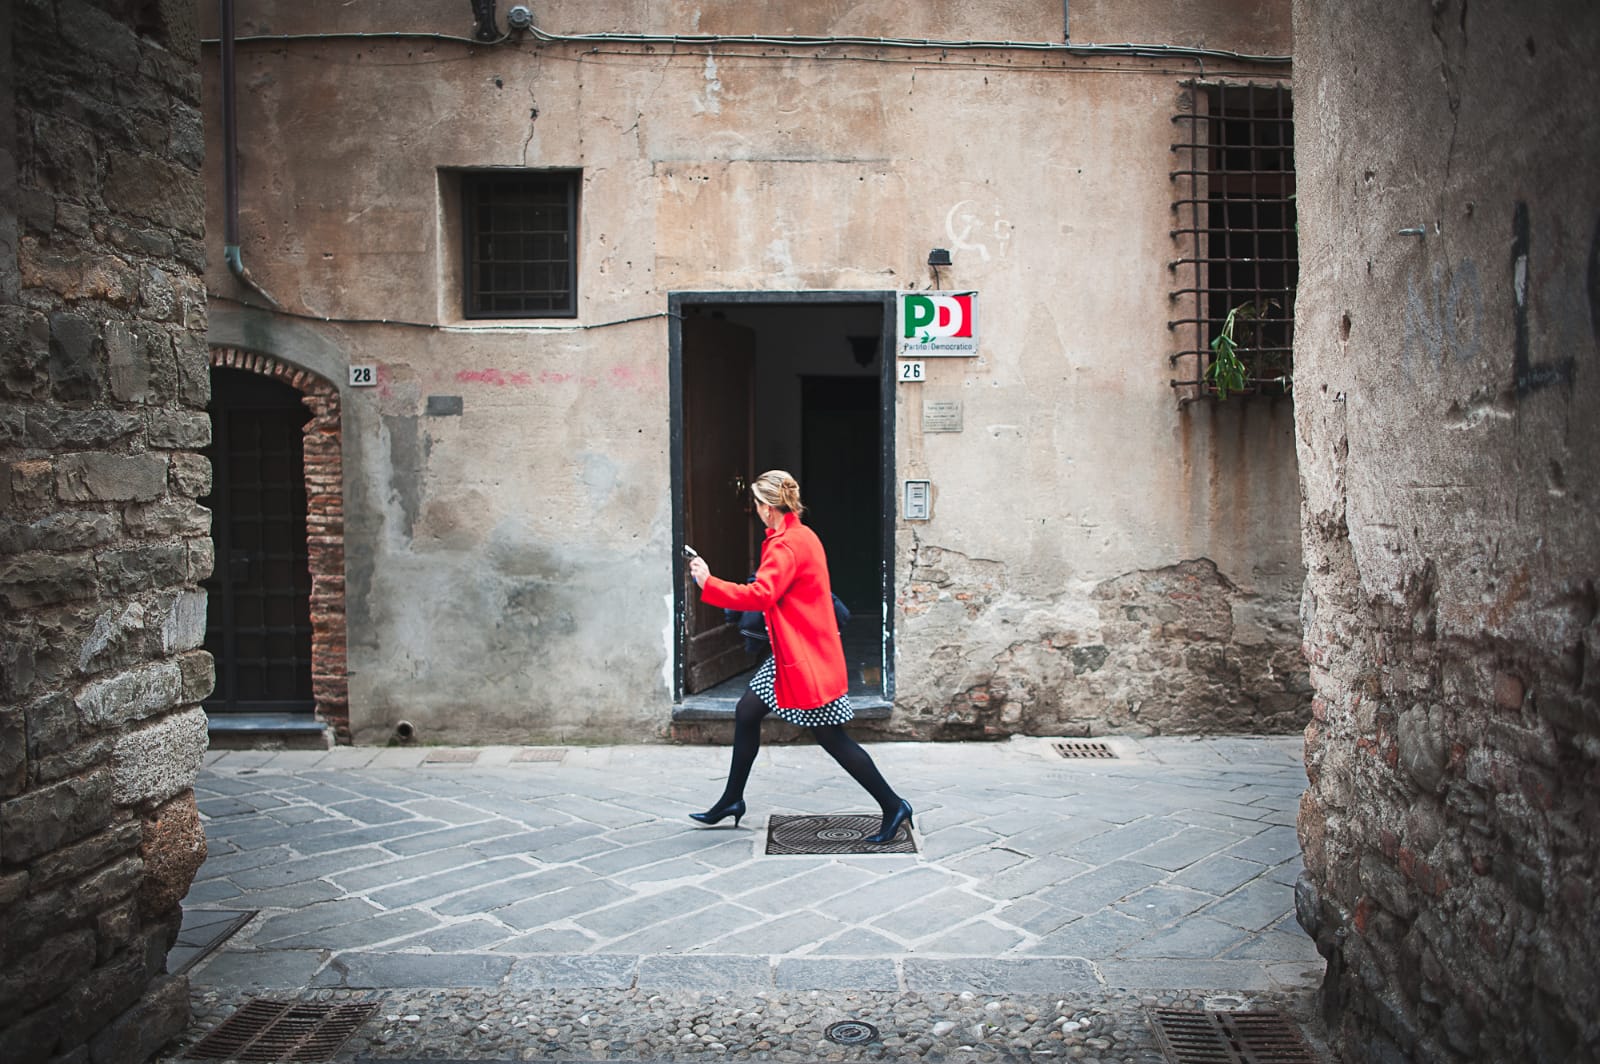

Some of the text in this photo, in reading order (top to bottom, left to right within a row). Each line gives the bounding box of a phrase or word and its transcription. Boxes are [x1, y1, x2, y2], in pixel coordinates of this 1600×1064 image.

[905, 295, 964, 338] PD
[904, 343, 973, 351] Partito Democratico
[354, 368, 371, 382] 28
[903, 364, 921, 378] 26
